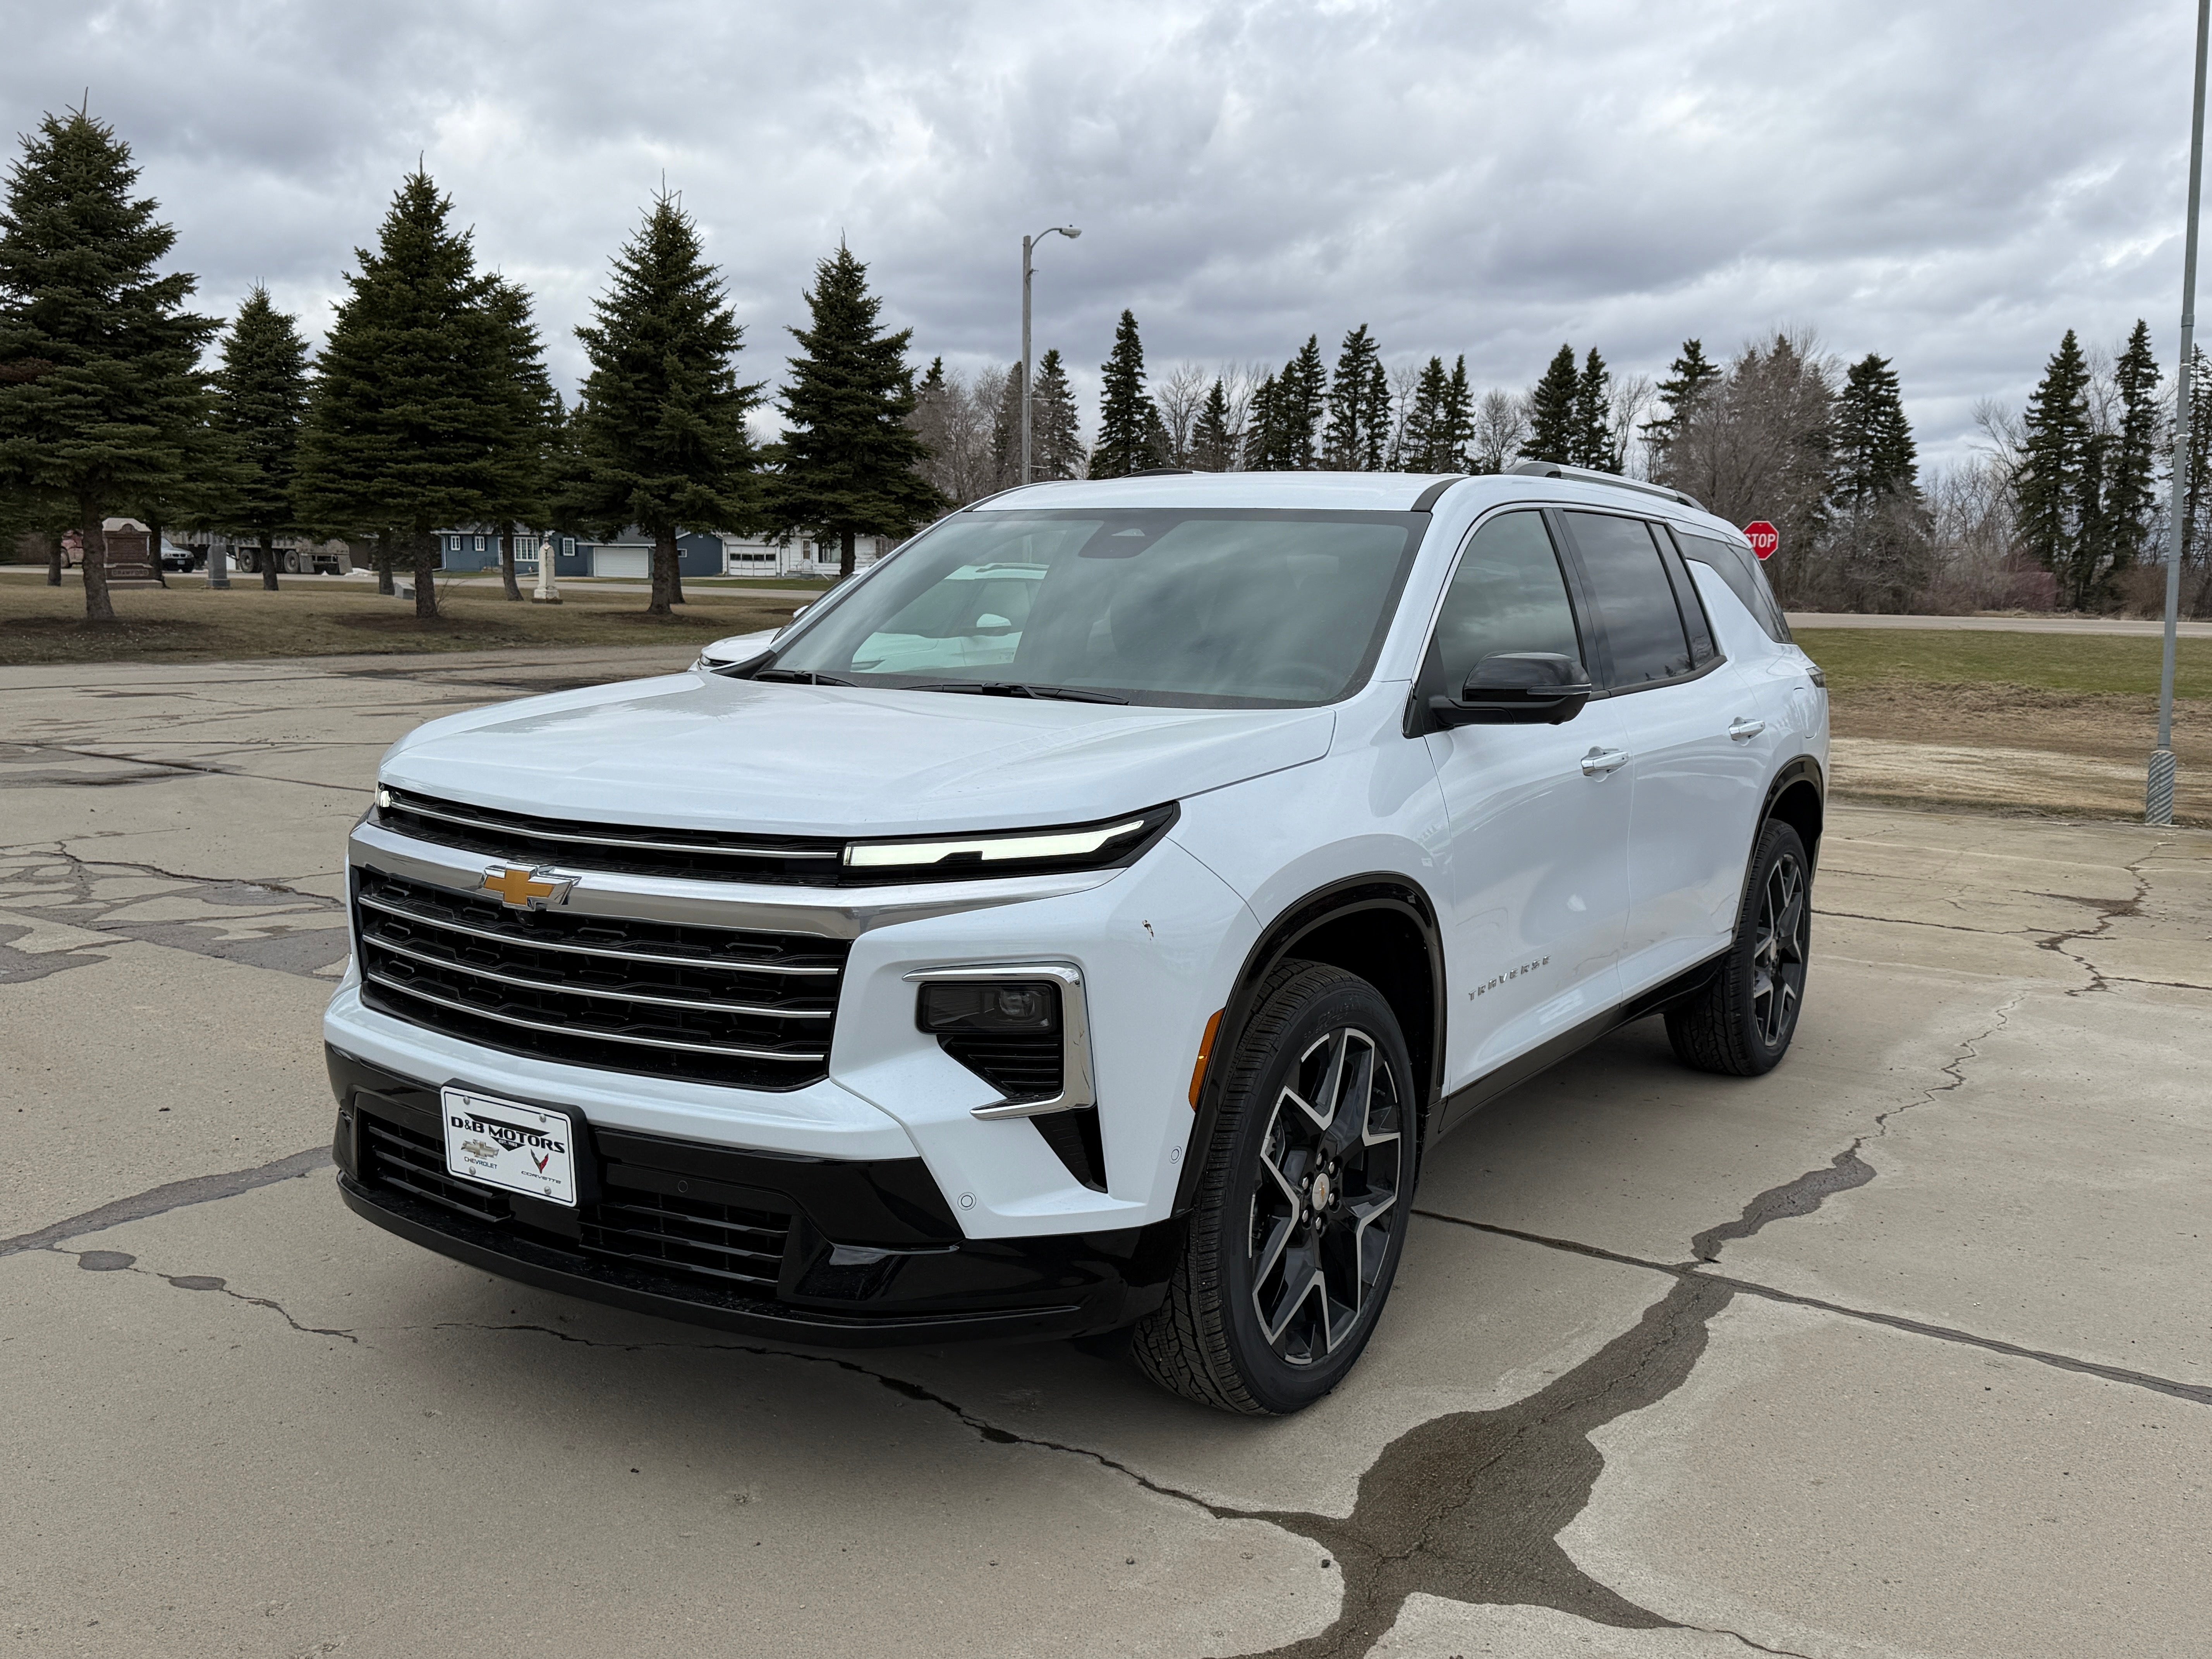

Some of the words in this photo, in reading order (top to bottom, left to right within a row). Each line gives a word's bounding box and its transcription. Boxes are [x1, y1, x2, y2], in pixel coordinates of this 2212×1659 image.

[1468, 954, 1551, 1001] TRAVERSE
[451, 1116, 484, 1133] D&B
[488, 1125, 565, 1154] MOTORS
[464, 1156, 497, 1169] CHEVROLET
[521, 1171, 562, 1184] CORVETTE
